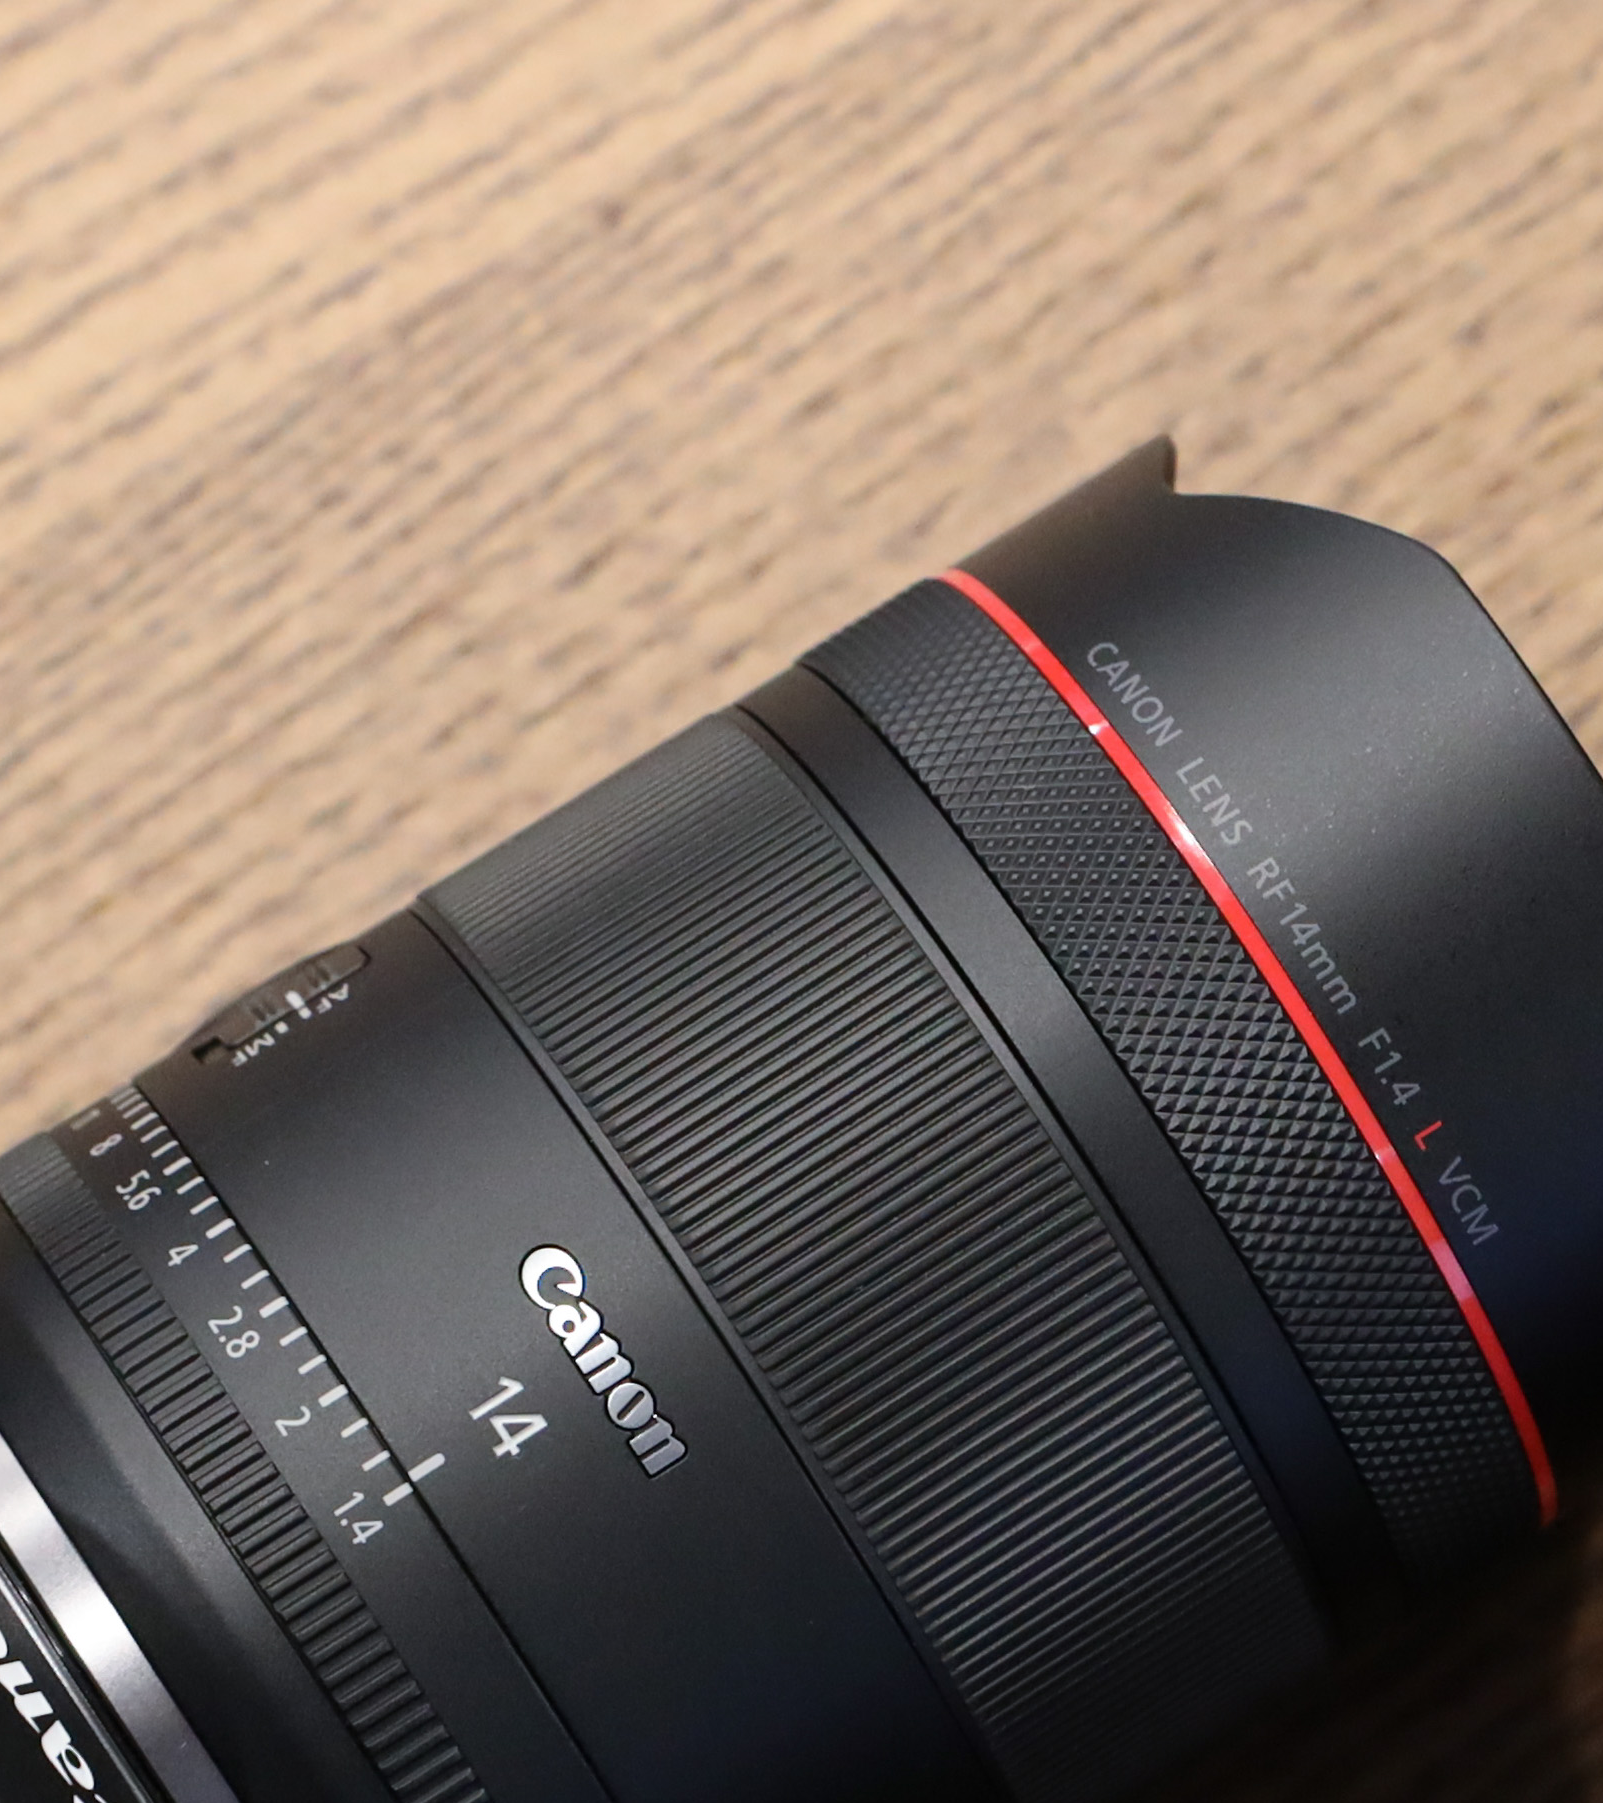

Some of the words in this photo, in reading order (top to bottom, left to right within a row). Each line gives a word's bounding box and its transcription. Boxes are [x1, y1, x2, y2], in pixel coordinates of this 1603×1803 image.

[1087, 642, 1182, 747] CANON
[1176, 757, 1253, 845] LENS
[1247, 857, 1357, 1015] RF14mm
[1358, 1027, 1420, 1107] F1.4
[1413, 1121, 1442, 1151] L
[1438, 1157, 1499, 1246] VCM
[89, 1133, 123, 1157] 8
[115, 1170, 162, 1210] 5.6
[167, 1243, 198, 1267] 4
[208, 1305, 260, 1358] 2.8
[275, 1407, 311, 1437] 2
[333, 1491, 384, 1545] 1.4
[469, 1376, 548, 1458] 14
[520, 1246, 688, 1478] Canon
